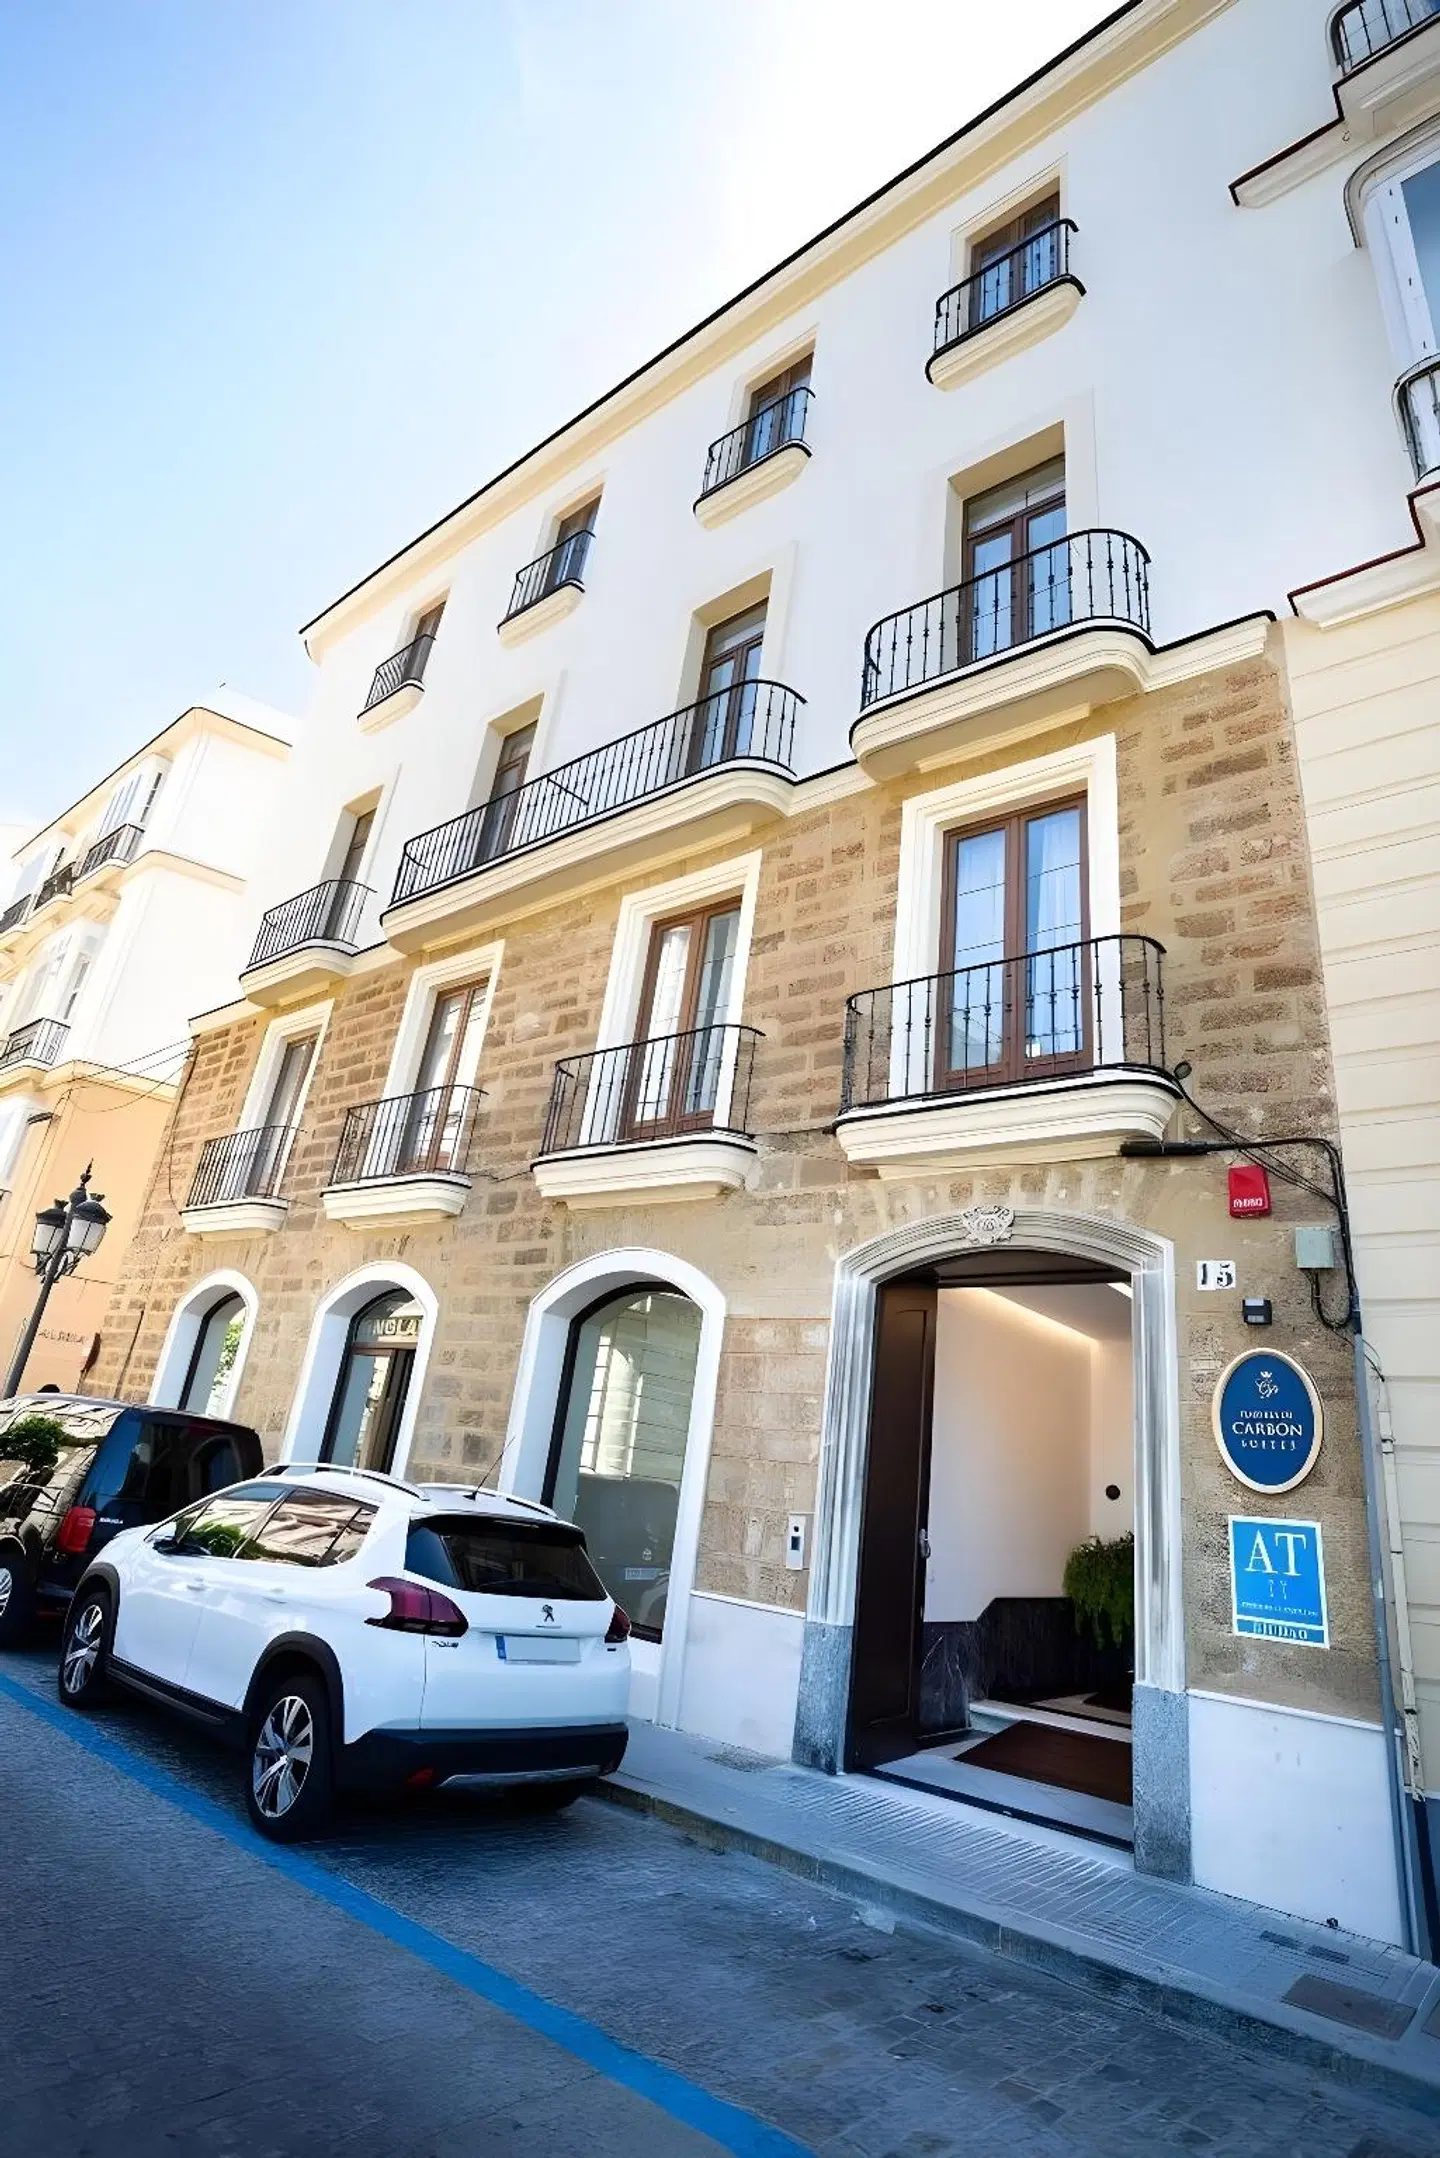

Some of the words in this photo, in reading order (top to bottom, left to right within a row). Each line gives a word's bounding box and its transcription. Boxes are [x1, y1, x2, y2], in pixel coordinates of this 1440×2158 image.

[1201, 1263, 1233, 1287] 15
[1232, 1421, 1303, 1437] CARBON
[1244, 1529, 1307, 1577] AT
